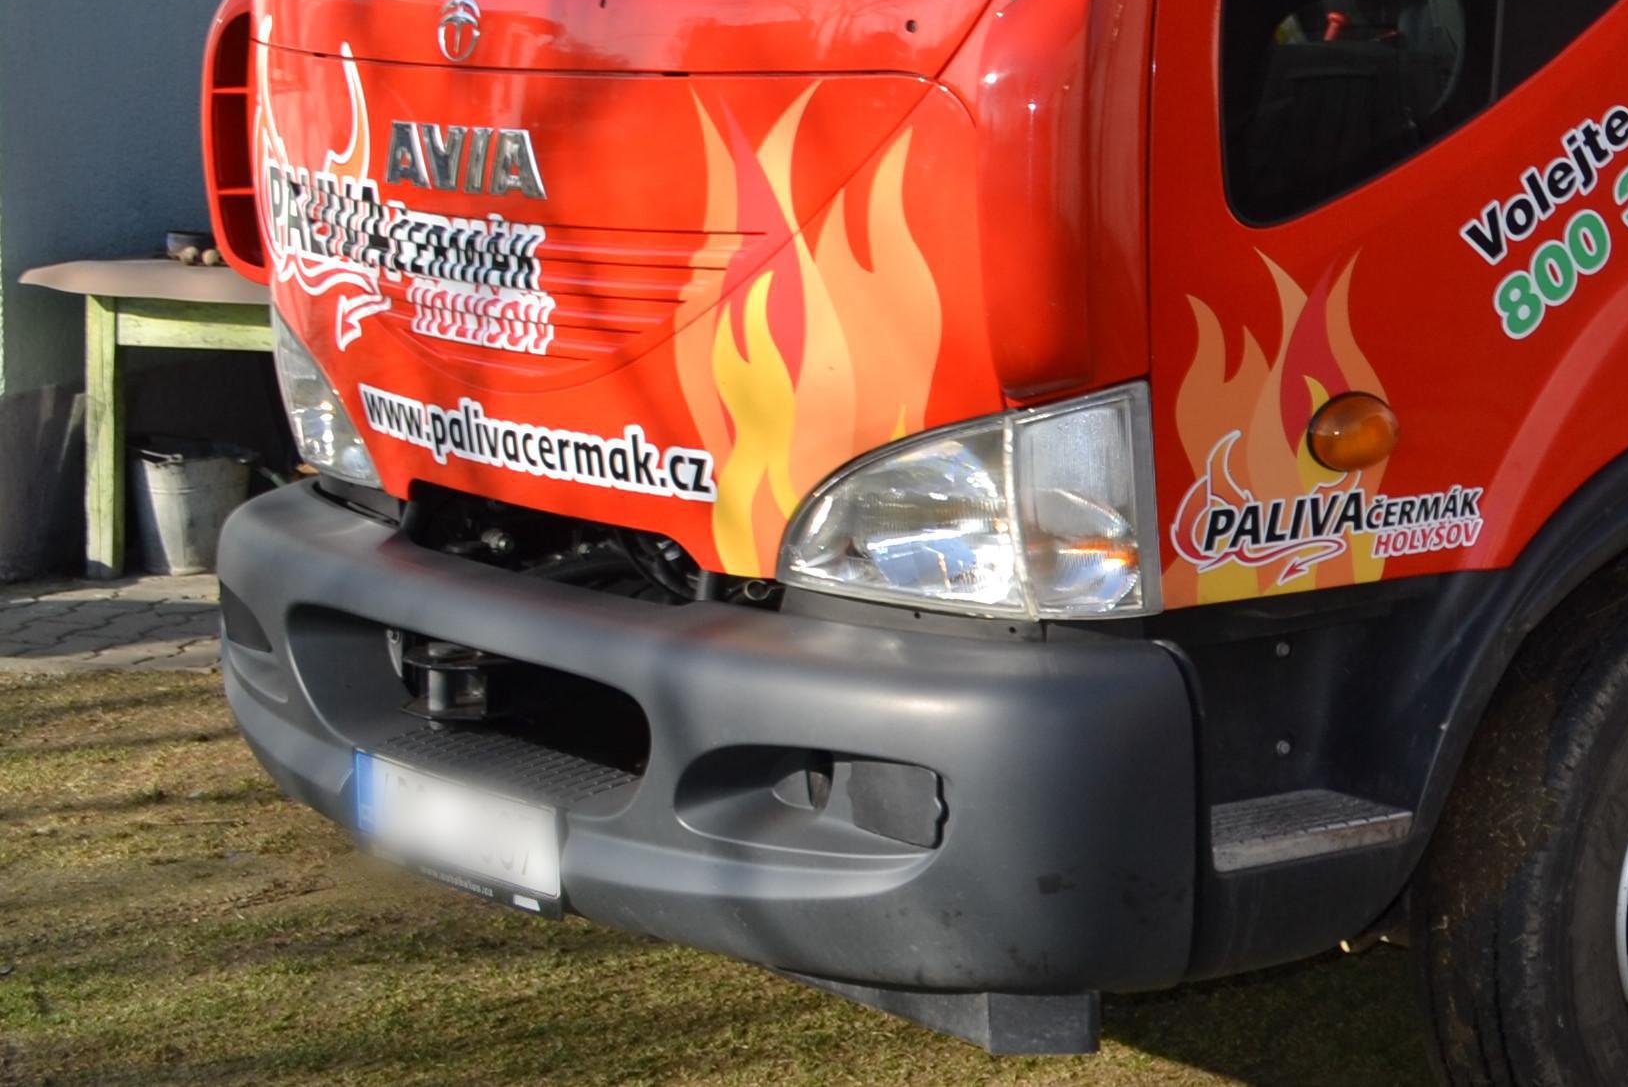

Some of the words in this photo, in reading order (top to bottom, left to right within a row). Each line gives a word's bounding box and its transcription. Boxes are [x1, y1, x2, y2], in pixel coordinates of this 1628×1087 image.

[386, 120, 547, 199] AVIA
[1497, 211, 1609, 337] 800
[363, 390, 713, 494] www.palivacermak.cz
[1202, 491, 1363, 552] PALIVA
[1365, 488, 1481, 530] ČERMÁK
[1374, 519, 1480, 556] HOLYŠOV
